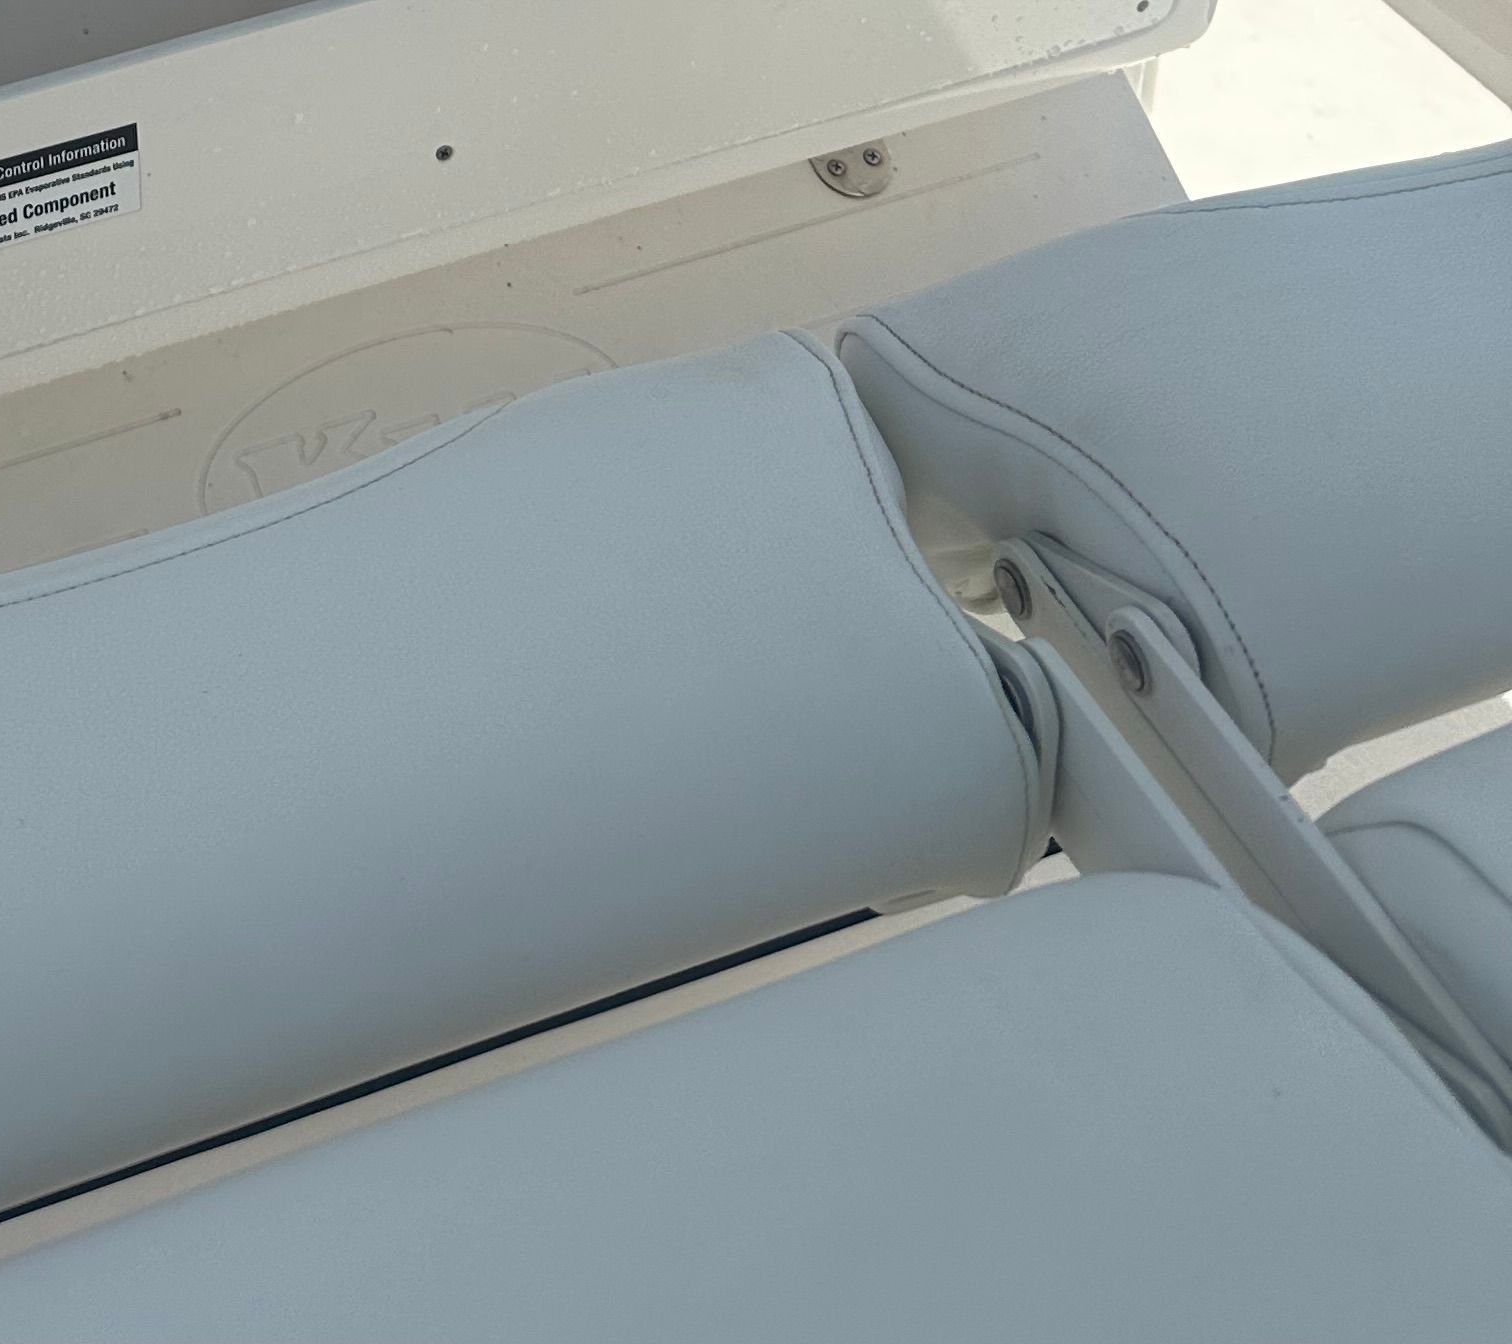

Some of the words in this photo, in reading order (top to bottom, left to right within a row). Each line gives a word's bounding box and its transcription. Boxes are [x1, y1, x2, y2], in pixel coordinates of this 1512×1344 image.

[48, 137, 125, 165] Information
[8, 188, 23, 199] EPA
[24, 177, 70, 194] Evaporative
[71, 165, 111, 181] Standards
[112, 159, 134, 170] Using
[22, 182, 115, 219] Component
[79, 211, 91, 220] SC
[93, 203, 118, 217] 29472
